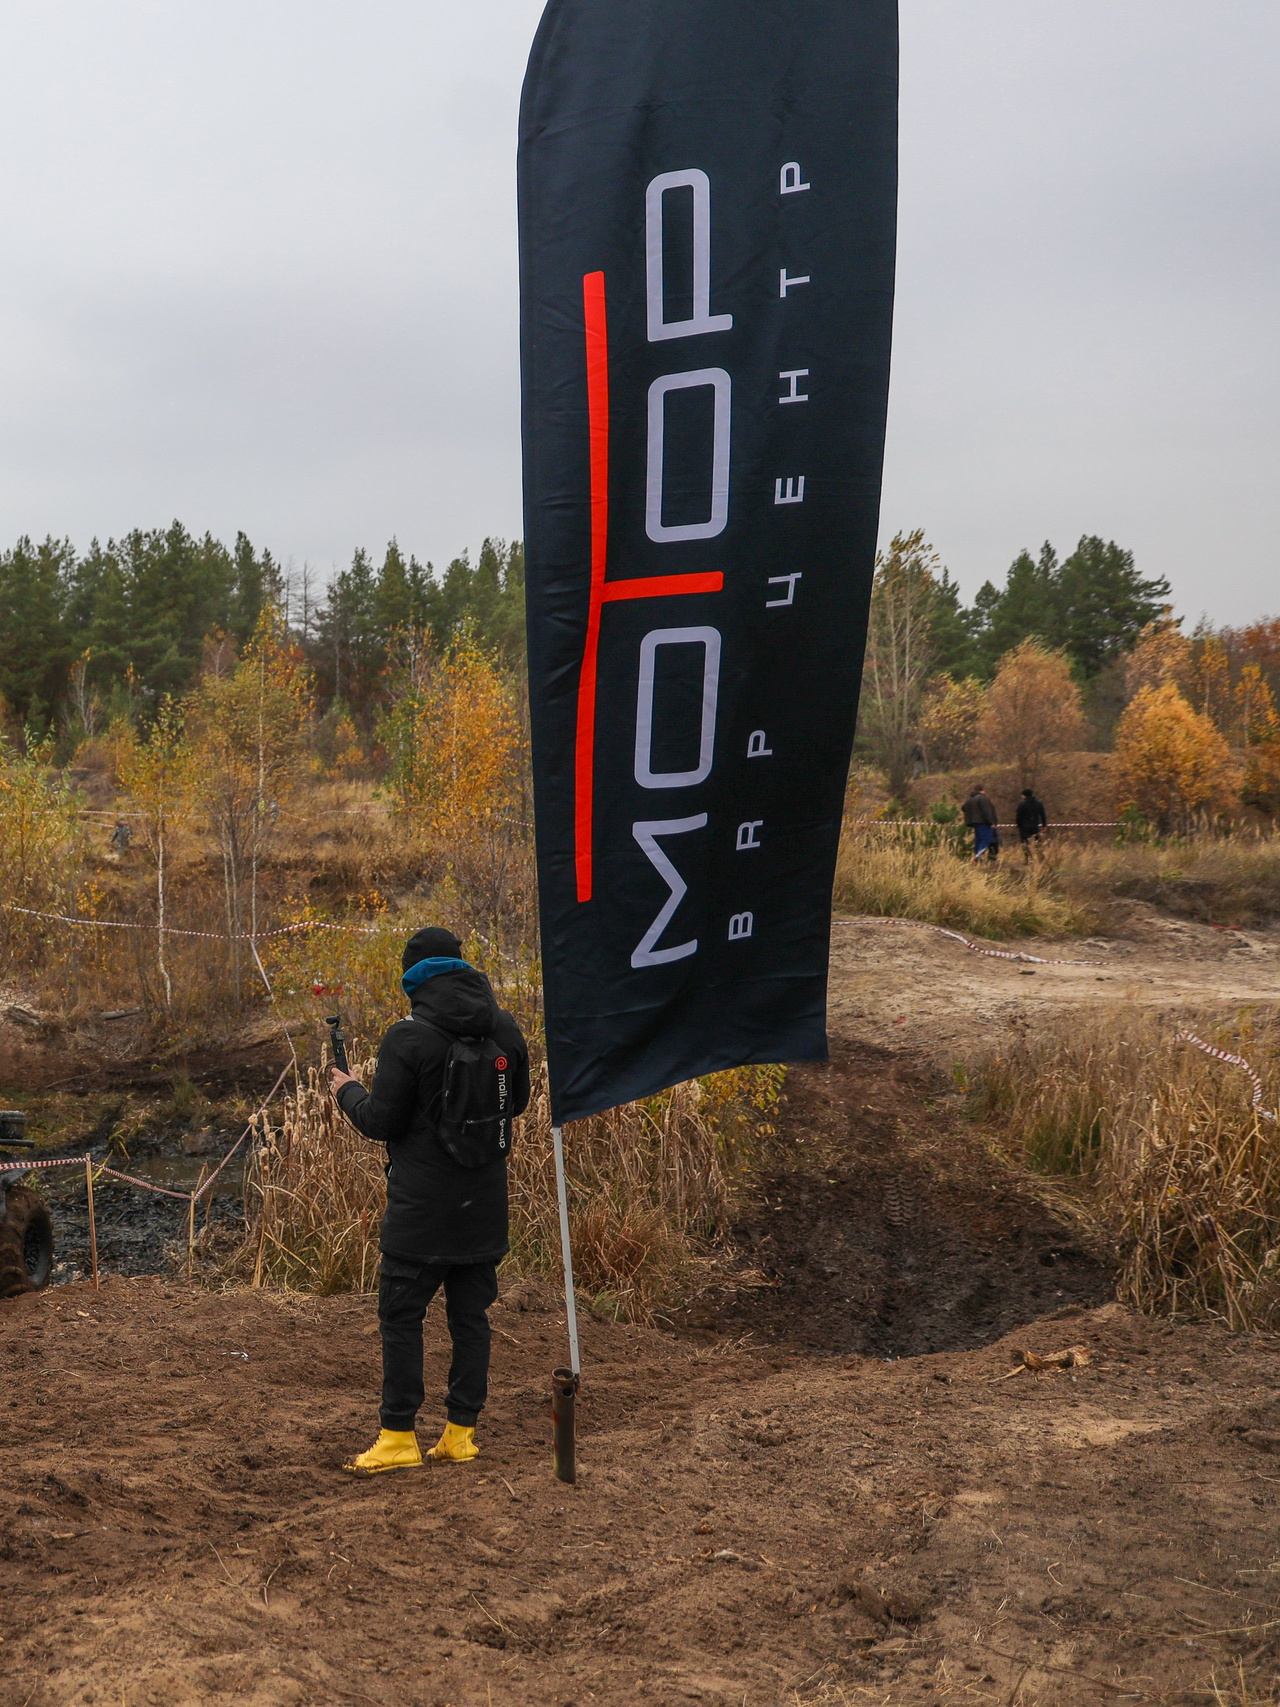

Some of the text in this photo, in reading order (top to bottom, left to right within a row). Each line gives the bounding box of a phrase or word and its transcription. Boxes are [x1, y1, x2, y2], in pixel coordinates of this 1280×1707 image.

[728, 161, 811, 941] BRP ЦЕНТР
[497, 1074, 508, 1110] mail.ru
